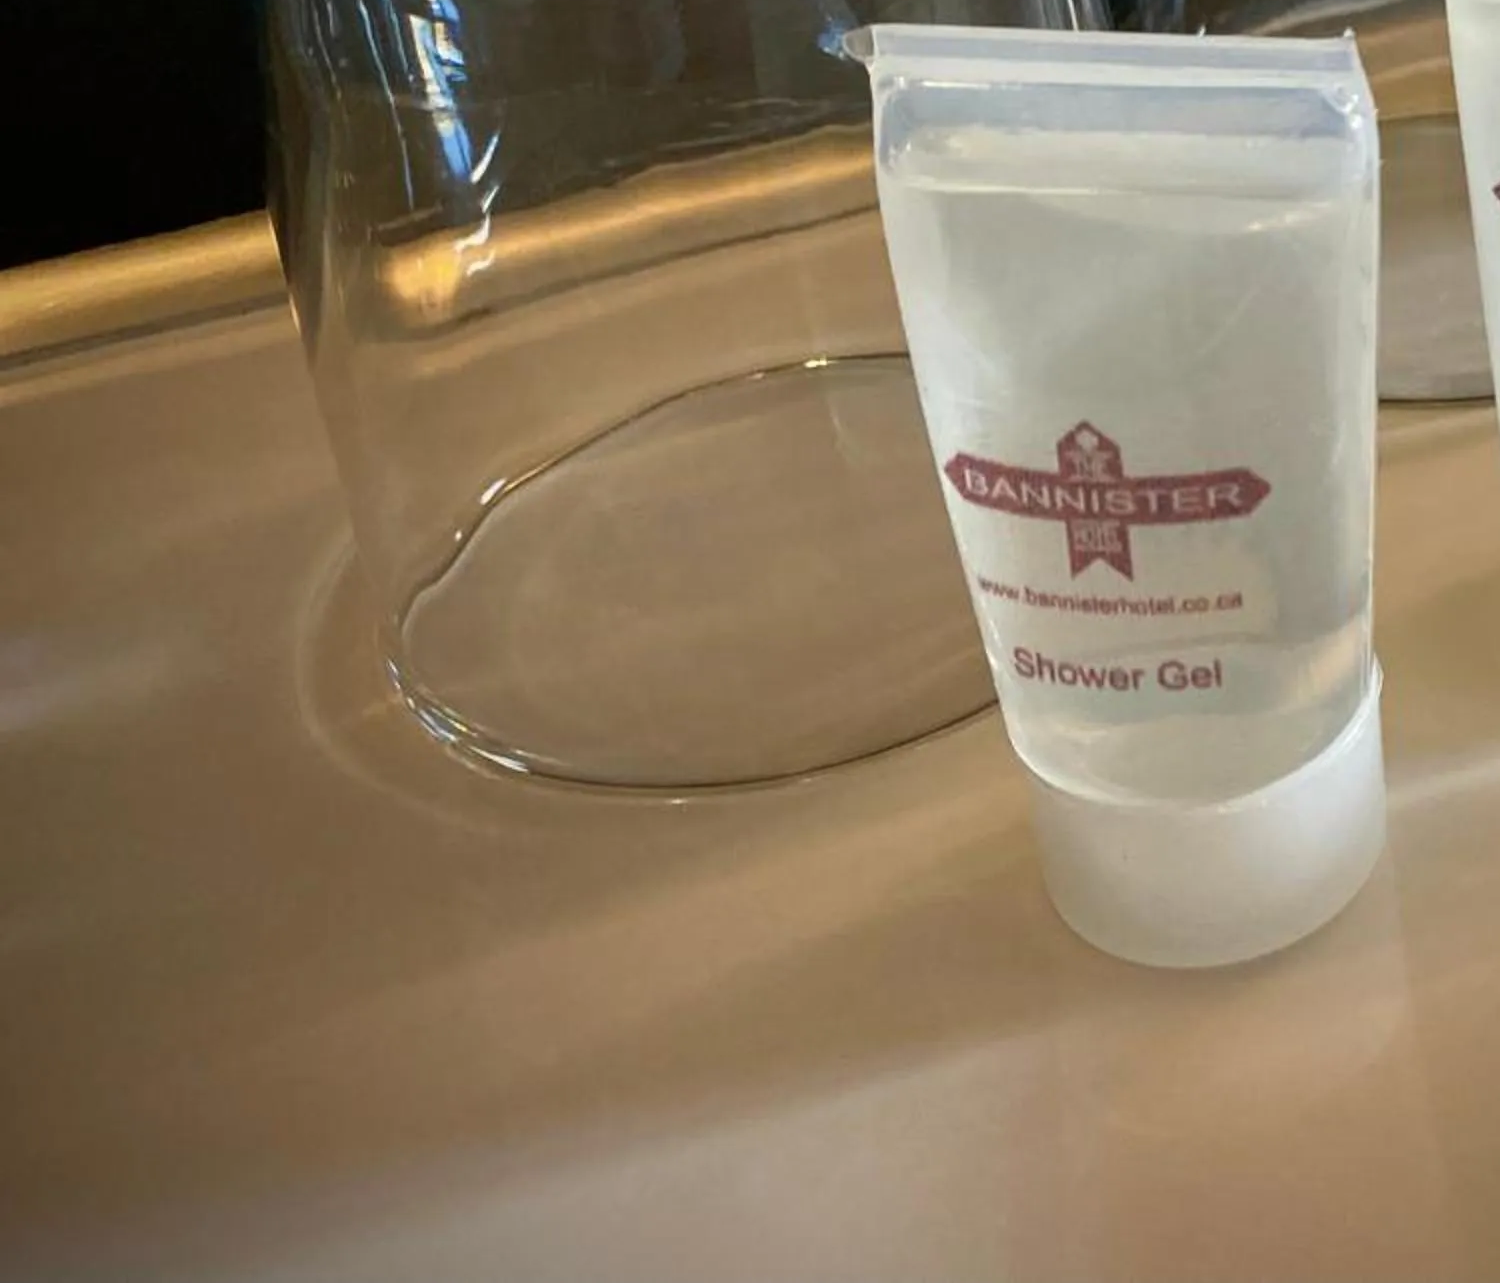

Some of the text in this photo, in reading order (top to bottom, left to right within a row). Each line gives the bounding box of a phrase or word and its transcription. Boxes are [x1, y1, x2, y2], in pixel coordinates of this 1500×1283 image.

[962, 467, 1245, 516] BANNISTER
[1013, 646, 1222, 692] Shower Gel
